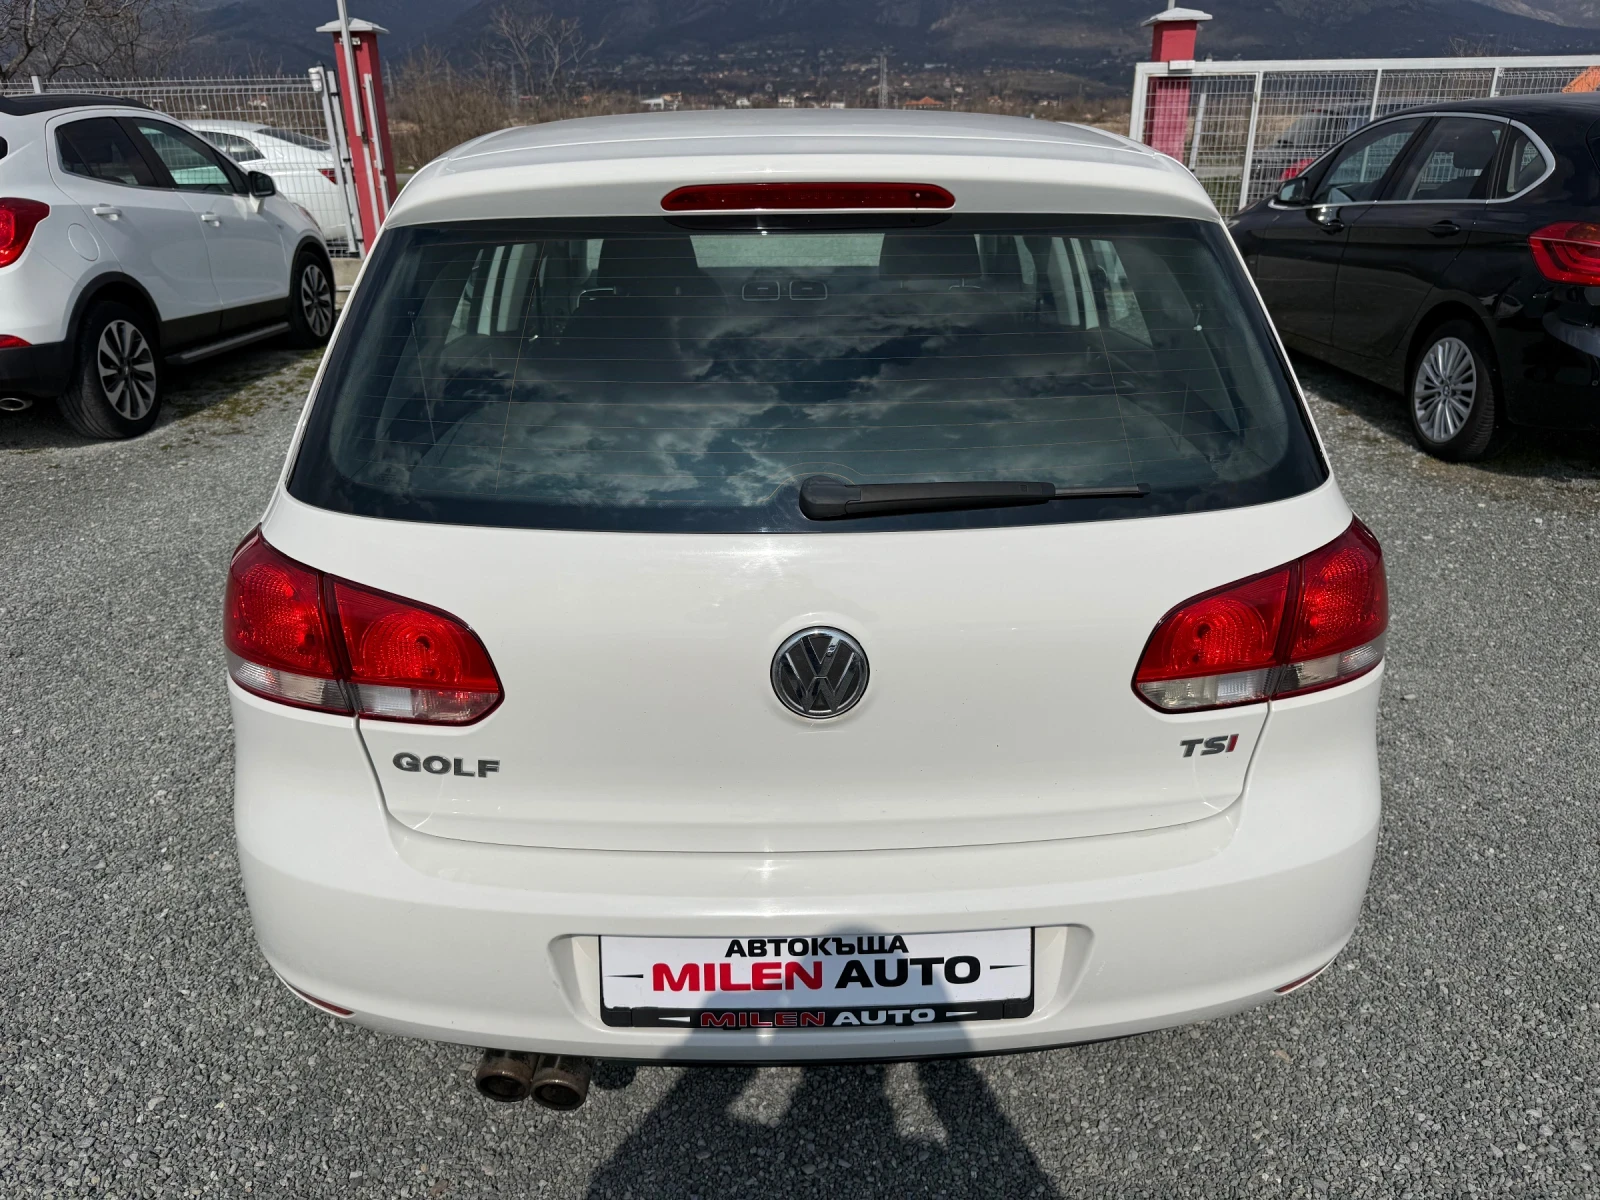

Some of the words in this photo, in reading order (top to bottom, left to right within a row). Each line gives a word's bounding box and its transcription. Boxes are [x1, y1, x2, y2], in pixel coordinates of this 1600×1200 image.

[1179, 733, 1239, 758] TSI
[392, 752, 501, 778] GOLF
[652, 961, 823, 992] MILEN
[835, 955, 981, 989] AUTO
[701, 1012, 825, 1027] MILEN
[832, 1008, 936, 1026] AUTO
